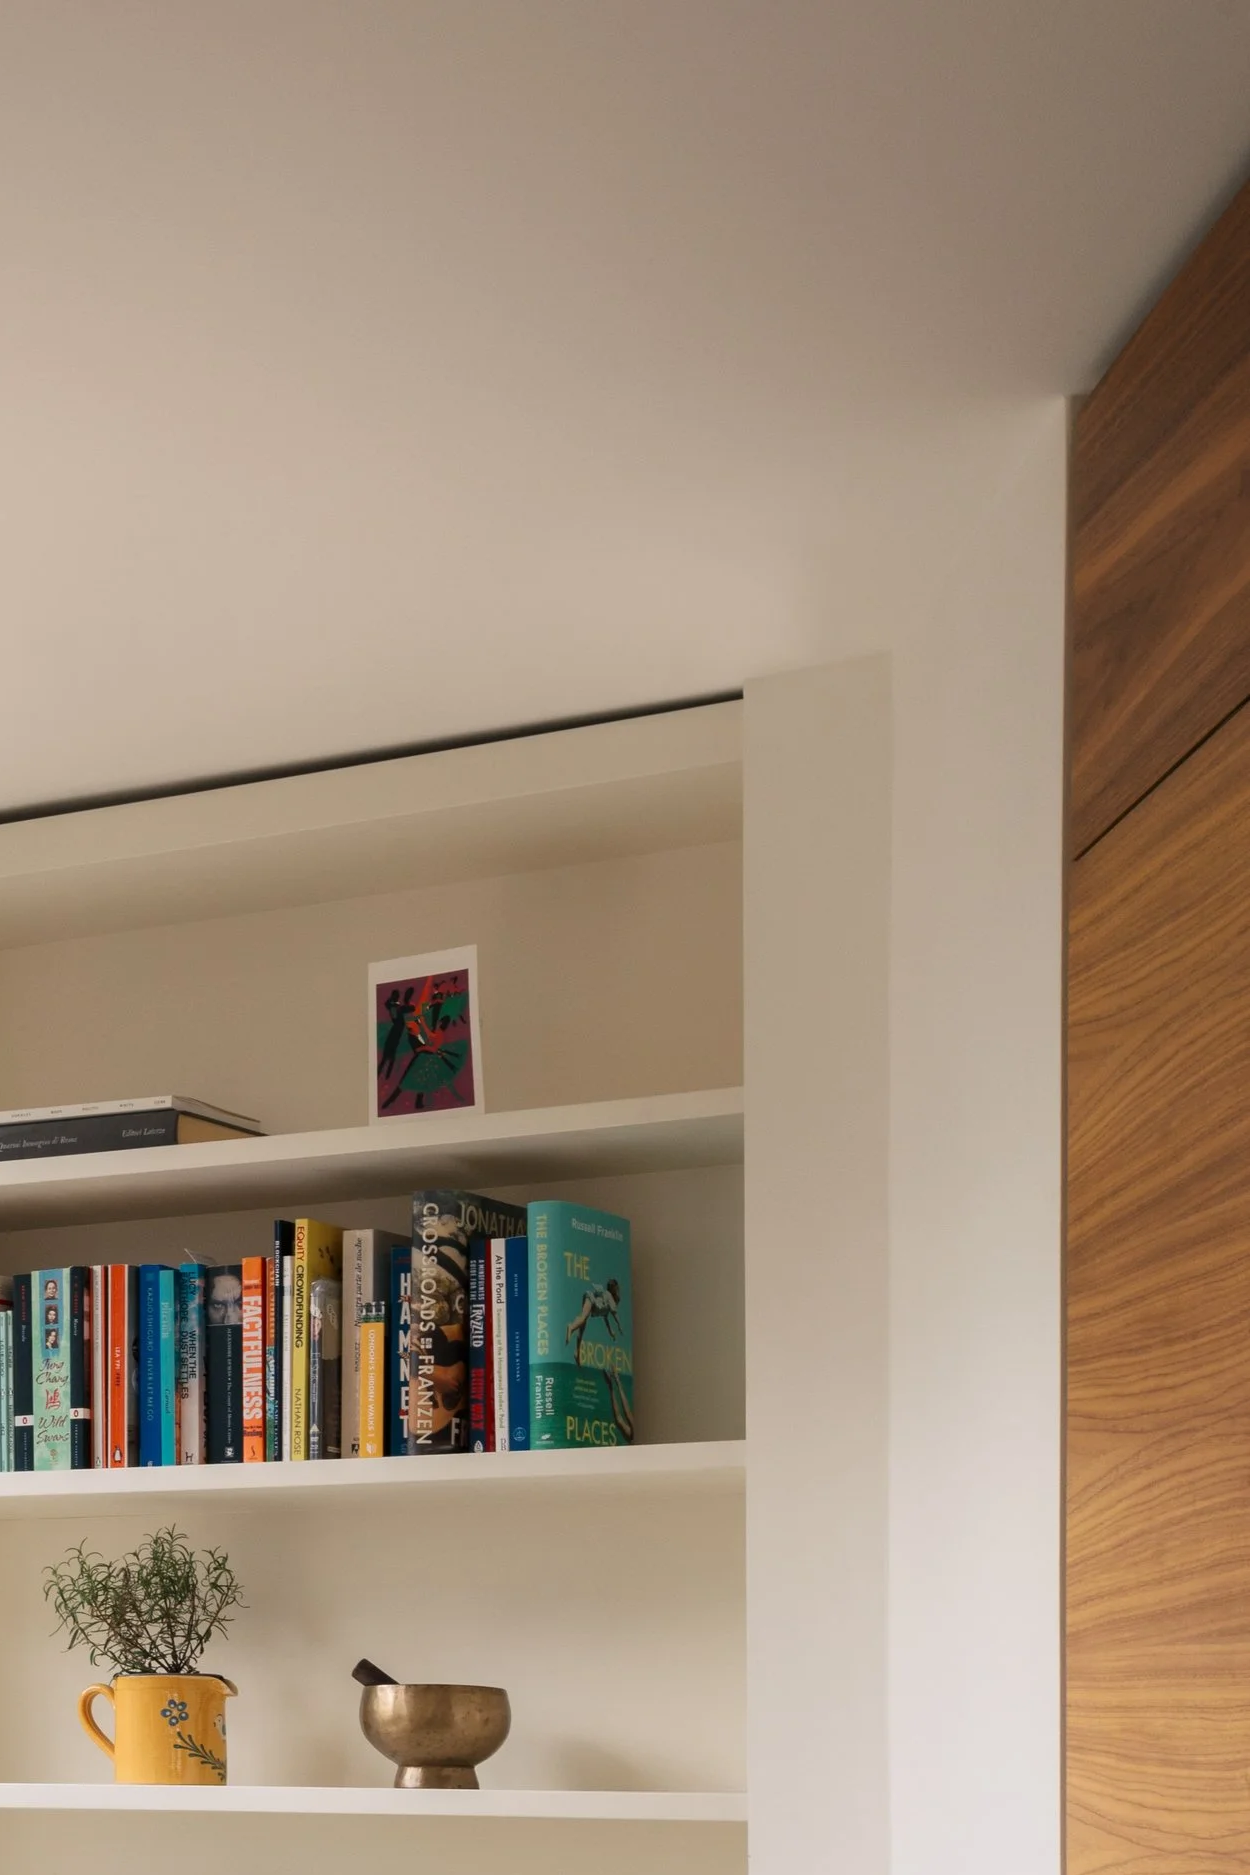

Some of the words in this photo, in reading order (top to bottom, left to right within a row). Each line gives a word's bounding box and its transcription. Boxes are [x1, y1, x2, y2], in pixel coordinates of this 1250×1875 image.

[457, 1200, 527, 1238] JONATHA
[536, 1214, 547, 1239] THE
[571, 1217, 596, 1234] Russell
[597, 1225, 623, 1242] Franklin
[296, 1225, 305, 1261] EQUITY
[495, 1255, 503, 1265] At
[355, 1263, 362, 1273] de
[419, 1203, 439, 1331] CROSSROADS
[536, 1244, 548, 1300] BROKEN
[563, 1251, 590, 1281] THE
[295, 1264, 305, 1349] CROWDFUNDING
[496, 1283, 505, 1304] Pond
[470, 1304, 485, 1348] FRAZZLED
[536, 1304, 549, 1356] PLACES
[181, 1331, 189, 1356] DUST
[243, 1295, 263, 1420] FACTFULNESS
[399, 1272, 411, 1439] HAMNET
[579, 1339, 632, 1373] BROKEN
[36, 1372, 70, 1387] Chang
[39, 1357, 64, 1373] Jung
[181, 1357, 189, 1399] SETTLES
[294, 1388, 302, 1422] NATHAN
[416, 1355, 435, 1444] FRANZEN
[535, 1375, 543, 1419] Franklin
[545, 1377, 554, 1416] Russell
[36, 1430, 70, 1445] Swans
[38, 1415, 69, 1430] Wild
[566, 1415, 617, 1446] PLACES
